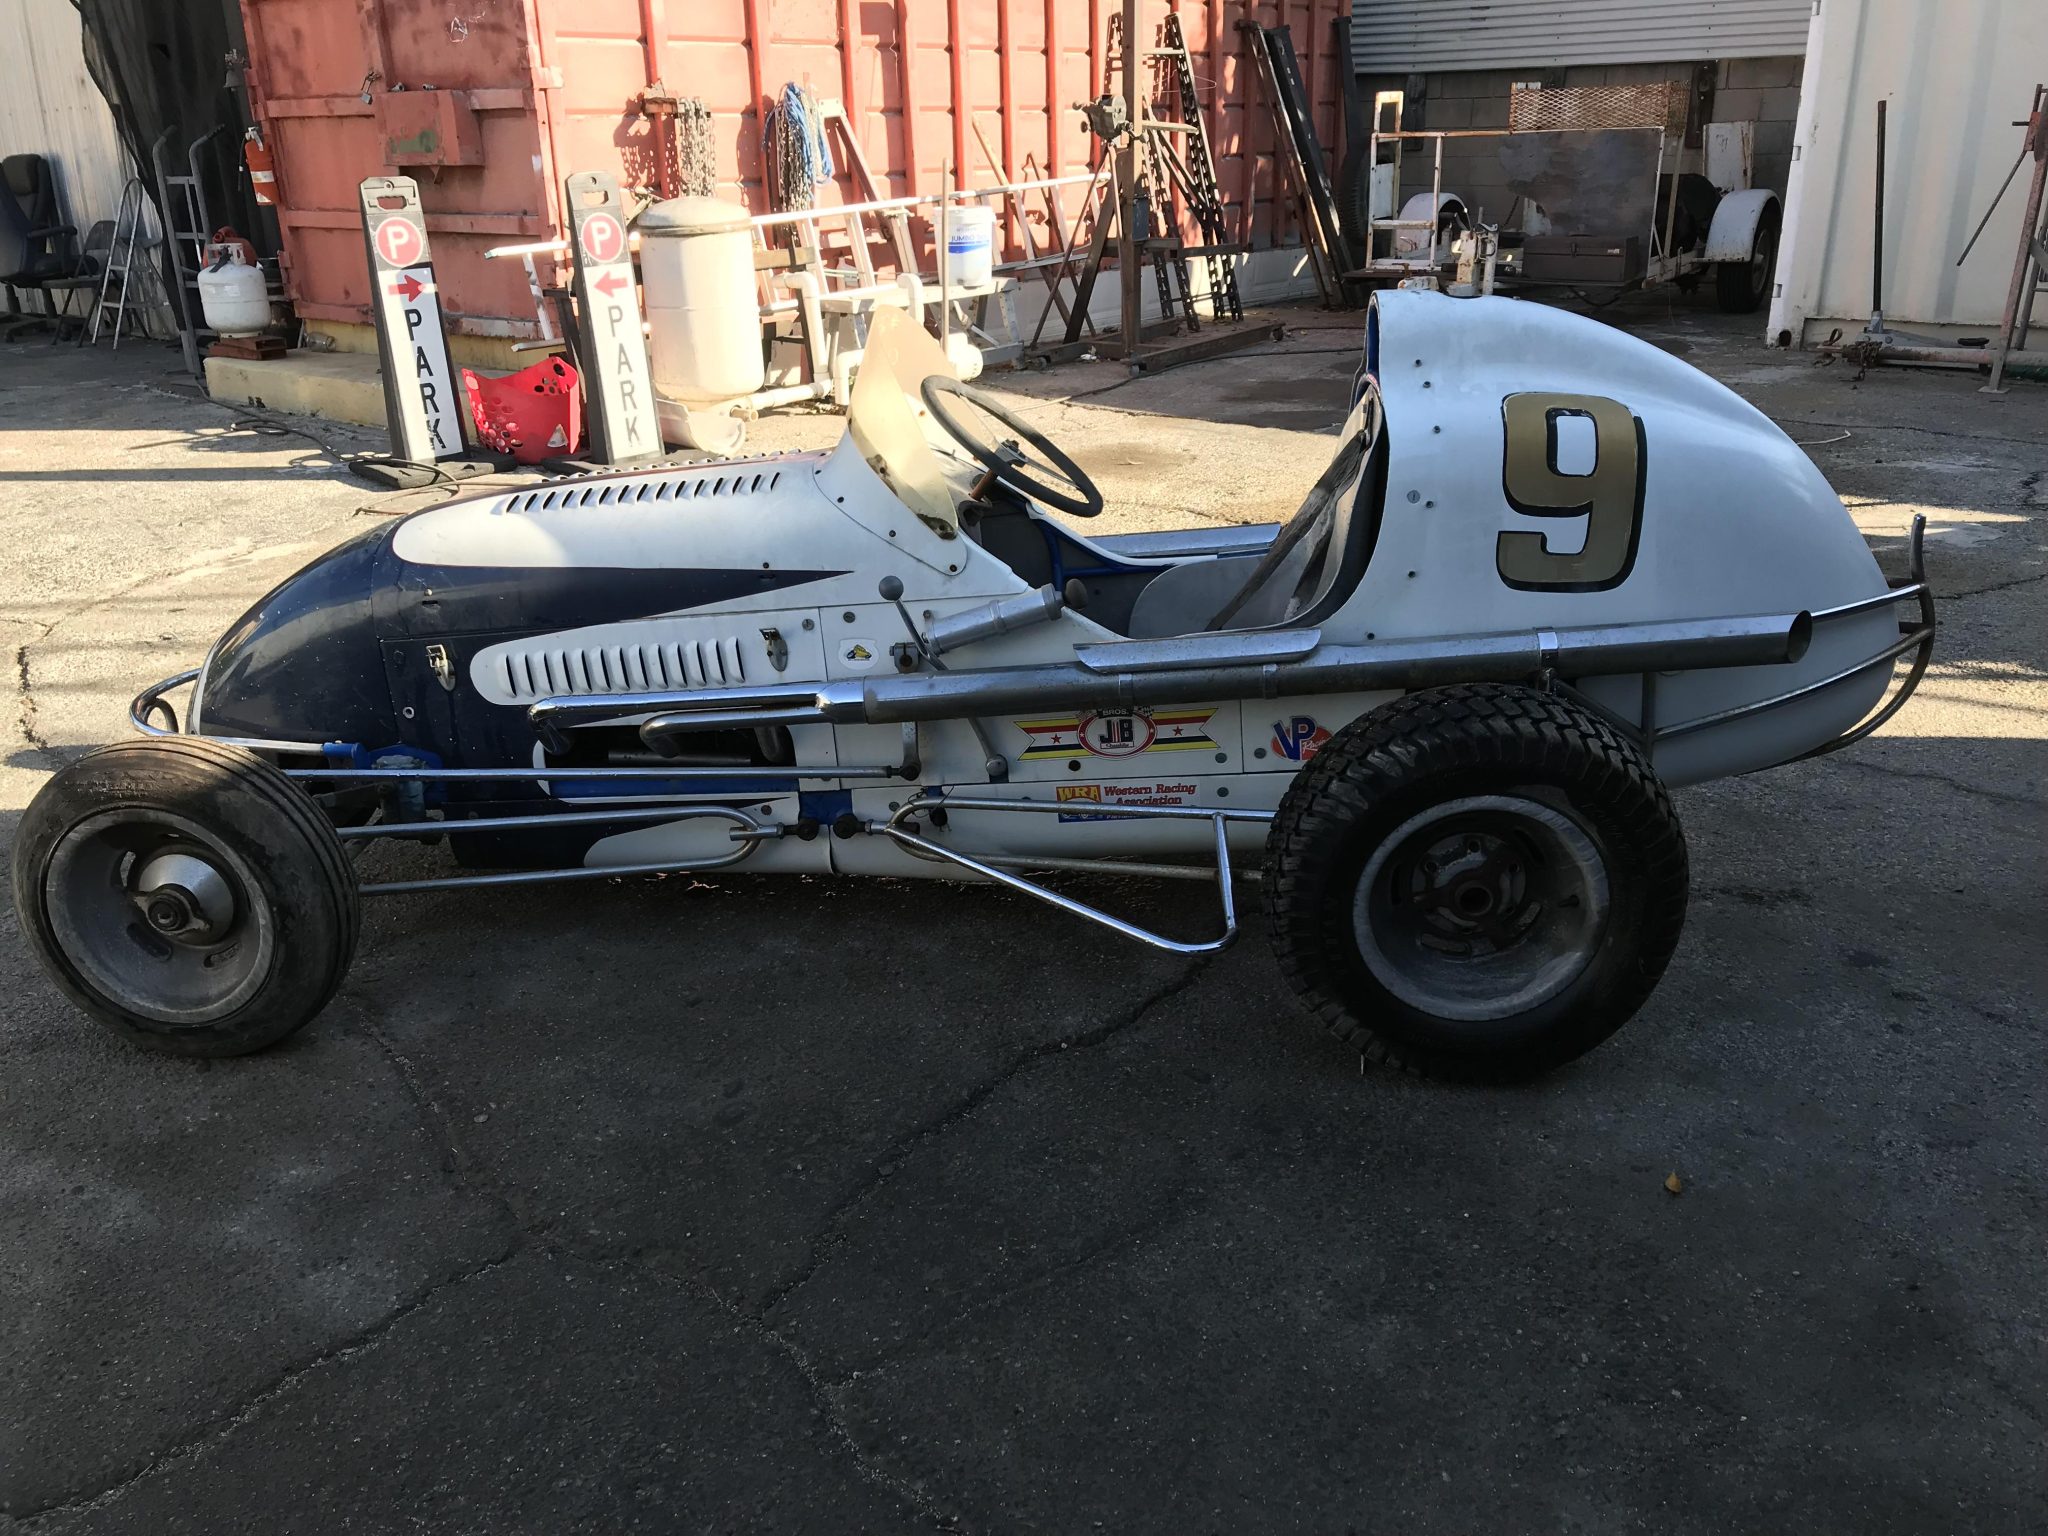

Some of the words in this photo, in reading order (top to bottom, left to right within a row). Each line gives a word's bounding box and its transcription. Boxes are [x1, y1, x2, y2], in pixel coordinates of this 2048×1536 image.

[385, 225, 410, 260] P
[589, 220, 612, 256] P
[404, 308, 447, 450] PARK
[608, 305, 642, 448] PARK
[1496, 391, 1648, 593] 9
[1102, 708, 1129, 716] BROS.
[1273, 716, 1317, 762] VP
[1057, 786, 1101, 801] WRA
[1104, 785, 1153, 796] Western
[1155, 783, 1197, 795] Racing
[1116, 795, 1183, 805] Association
